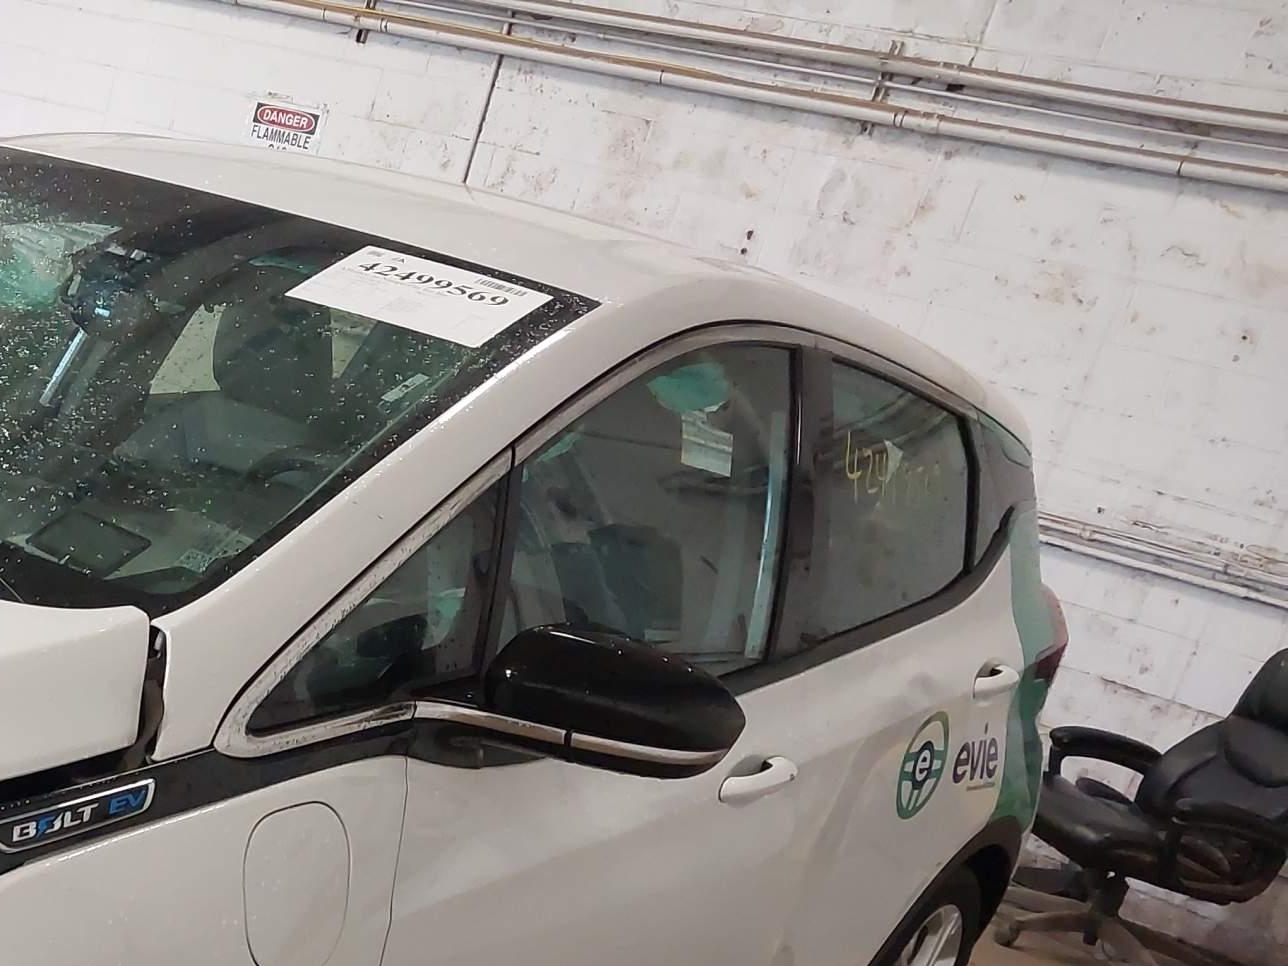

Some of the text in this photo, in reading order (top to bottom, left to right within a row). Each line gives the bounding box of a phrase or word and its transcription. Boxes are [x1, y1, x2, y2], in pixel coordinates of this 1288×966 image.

[251, 124, 311, 150] FLAMMABLE
[263, 109, 308, 129] DANGER
[358, 261, 510, 306] 42499569
[952, 722, 999, 784] evie
[12, 788, 147, 842] BOLT EV
